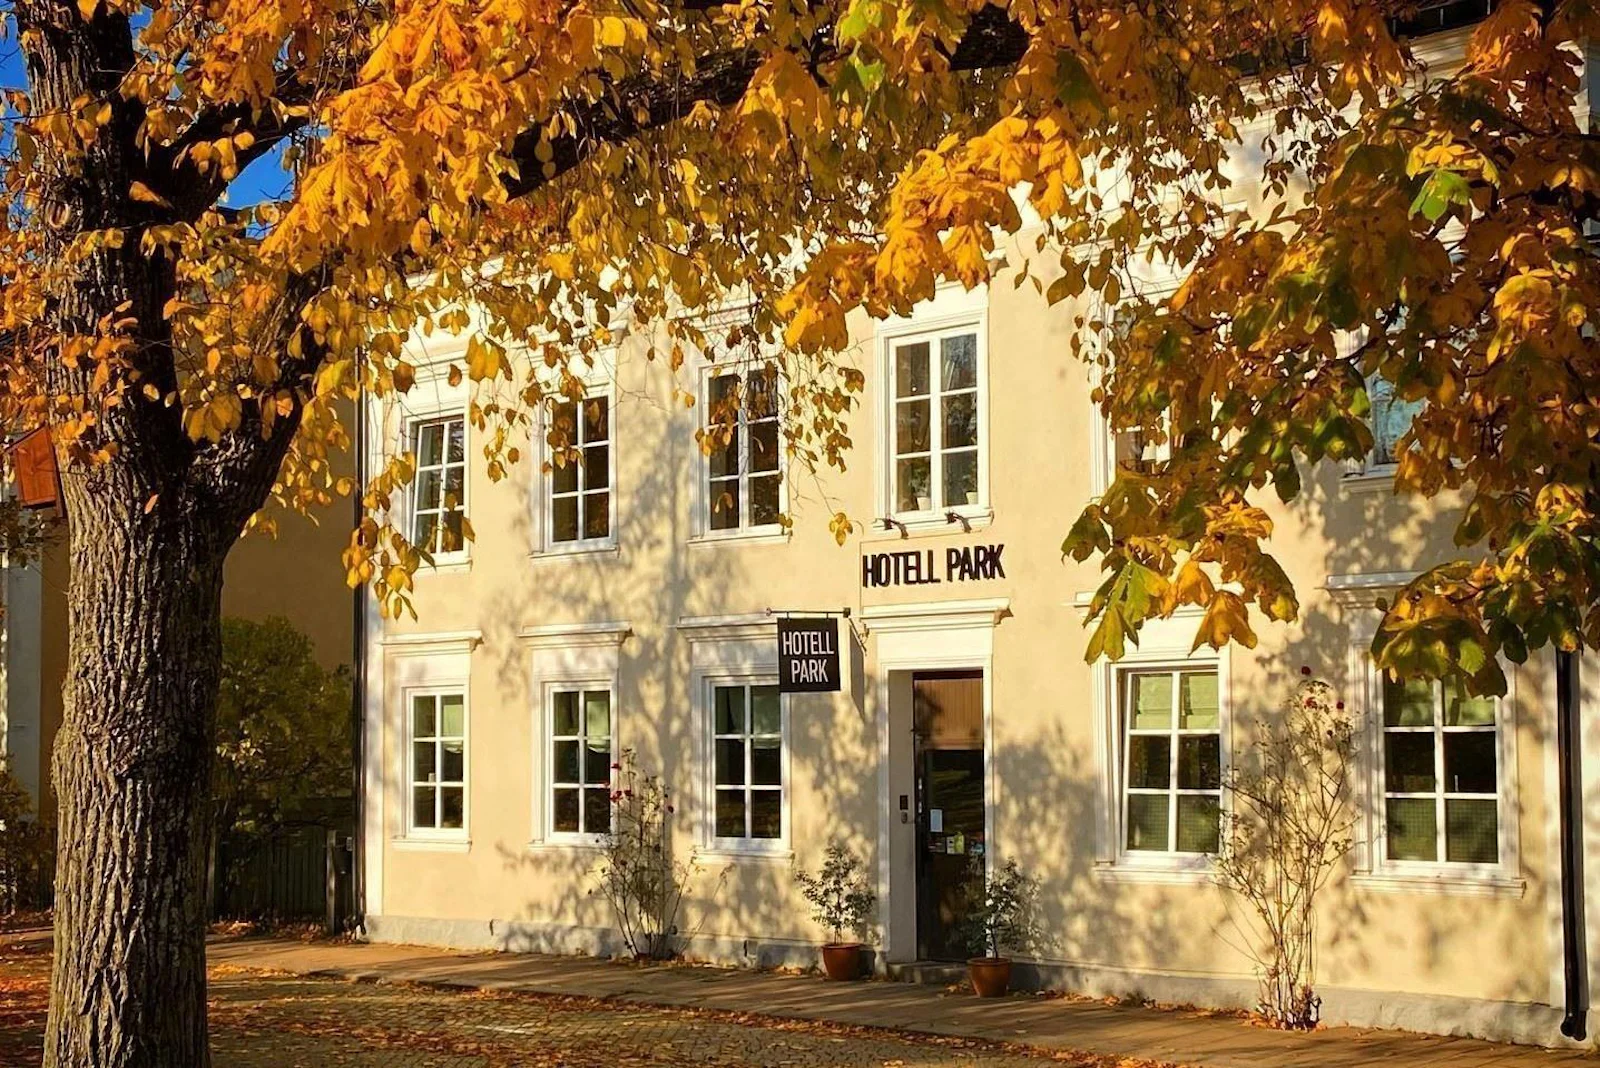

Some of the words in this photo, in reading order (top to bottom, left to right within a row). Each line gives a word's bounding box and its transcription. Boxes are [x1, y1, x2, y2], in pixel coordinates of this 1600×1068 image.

[862, 550, 941, 588] HOTELL
[946, 544, 1006, 582] PARK
[782, 631, 835, 655] HOTELL
[790, 659, 829, 683] PARK
